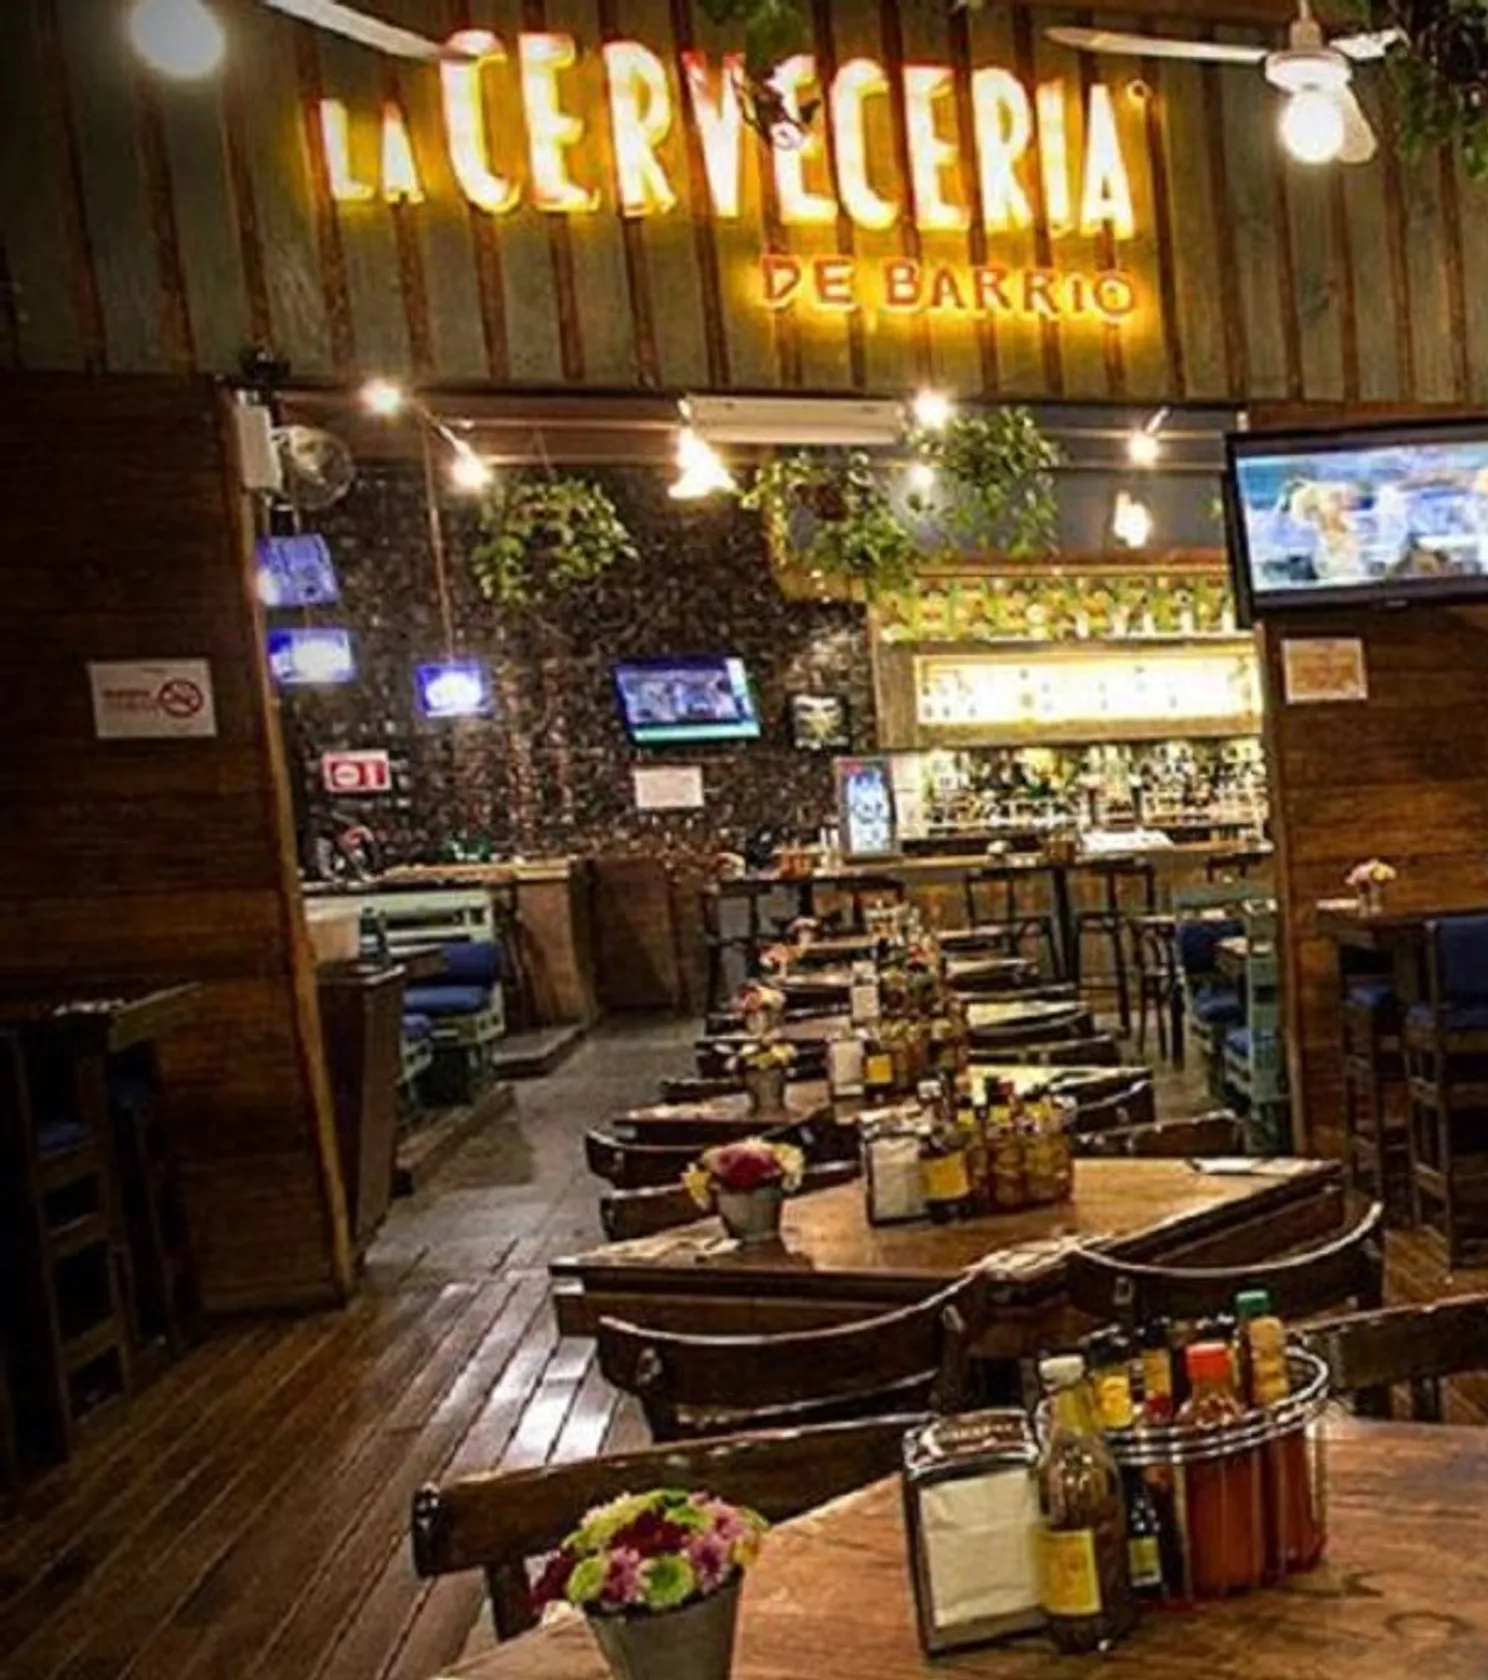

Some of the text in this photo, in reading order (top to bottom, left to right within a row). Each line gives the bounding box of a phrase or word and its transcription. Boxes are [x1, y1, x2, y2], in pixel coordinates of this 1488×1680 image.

[320, 98, 425, 204] LA
[761, 255, 1135, 320] DE BARRIO
